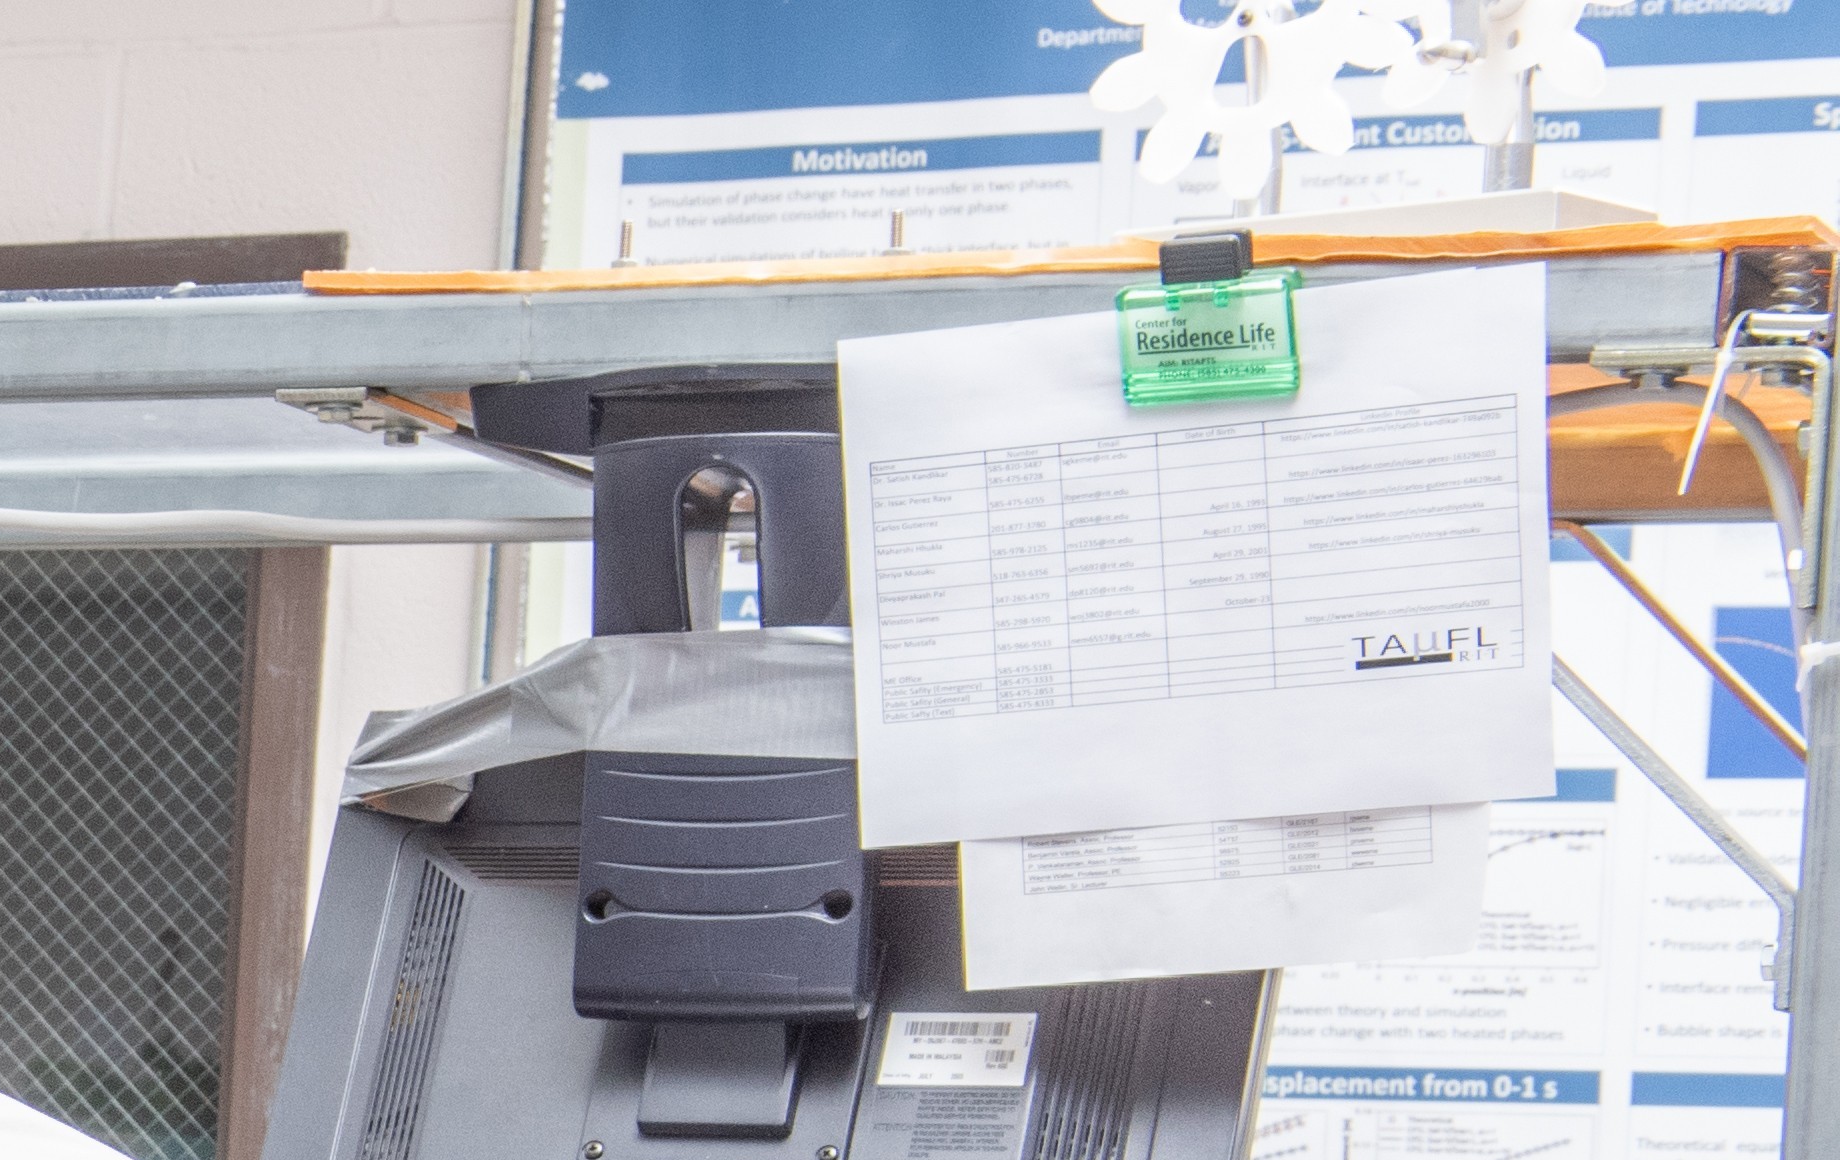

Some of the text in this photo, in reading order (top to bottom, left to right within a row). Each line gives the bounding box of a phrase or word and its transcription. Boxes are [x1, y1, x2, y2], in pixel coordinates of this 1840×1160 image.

[791, 148, 928, 173] Motivation
[1561, 161, 1612, 182] Liquid
[649, 193, 723, 209] Simulation
[725, 191, 741, 206] of
[743, 190, 782, 207] phase
[791, 188, 836, 204] change
[840, 186, 875, 200] have
[879, 184, 912, 199] heat
[915, 182, 969, 197] transfer
[970, 180, 985, 193] in
[989, 179, 1016, 193] two
[648, 214, 672, 229] but
[675, 213, 708, 228] their
[711, 210, 778, 227] validation
[781, 207, 848, 222] considers
[851, 204, 884, 219] heat
[938, 204, 963, 216] one
[1135, 317, 1188, 330] Center for
[1137, 323, 1276, 351] Residence Life
[872, 463, 896, 472] Name
[1006, 448, 1039, 459] Number
[1097, 440, 1121, 449] Email
[1459, 648, 1501, 663] RIT
[898, 675, 923, 684] Office
[1664, 897, 1743, 911] Negligible
[1661, 939, 1730, 951] Pressure
[1659, 981, 1731, 994] Interface
[1276, 1004, 1508, 1021] etween theory and simulation
[1320, 1025, 1375, 1042] change
[1379, 1026, 1413, 1040] with
[1417, 1027, 1447, 1040] two
[1451, 1027, 1507, 1041] heated
[1510, 1027, 1566, 1043] phases
[1656, 1024, 1712, 1038] Bubble
[1717, 1025, 1766, 1039] shape
[1422, 1073, 1488, 1099] from
[1493, 1075, 1537, 1099] 0-1
[1541, 1079, 1559, 1099] s
[1637, 1137, 1727, 1153] Theoretical
